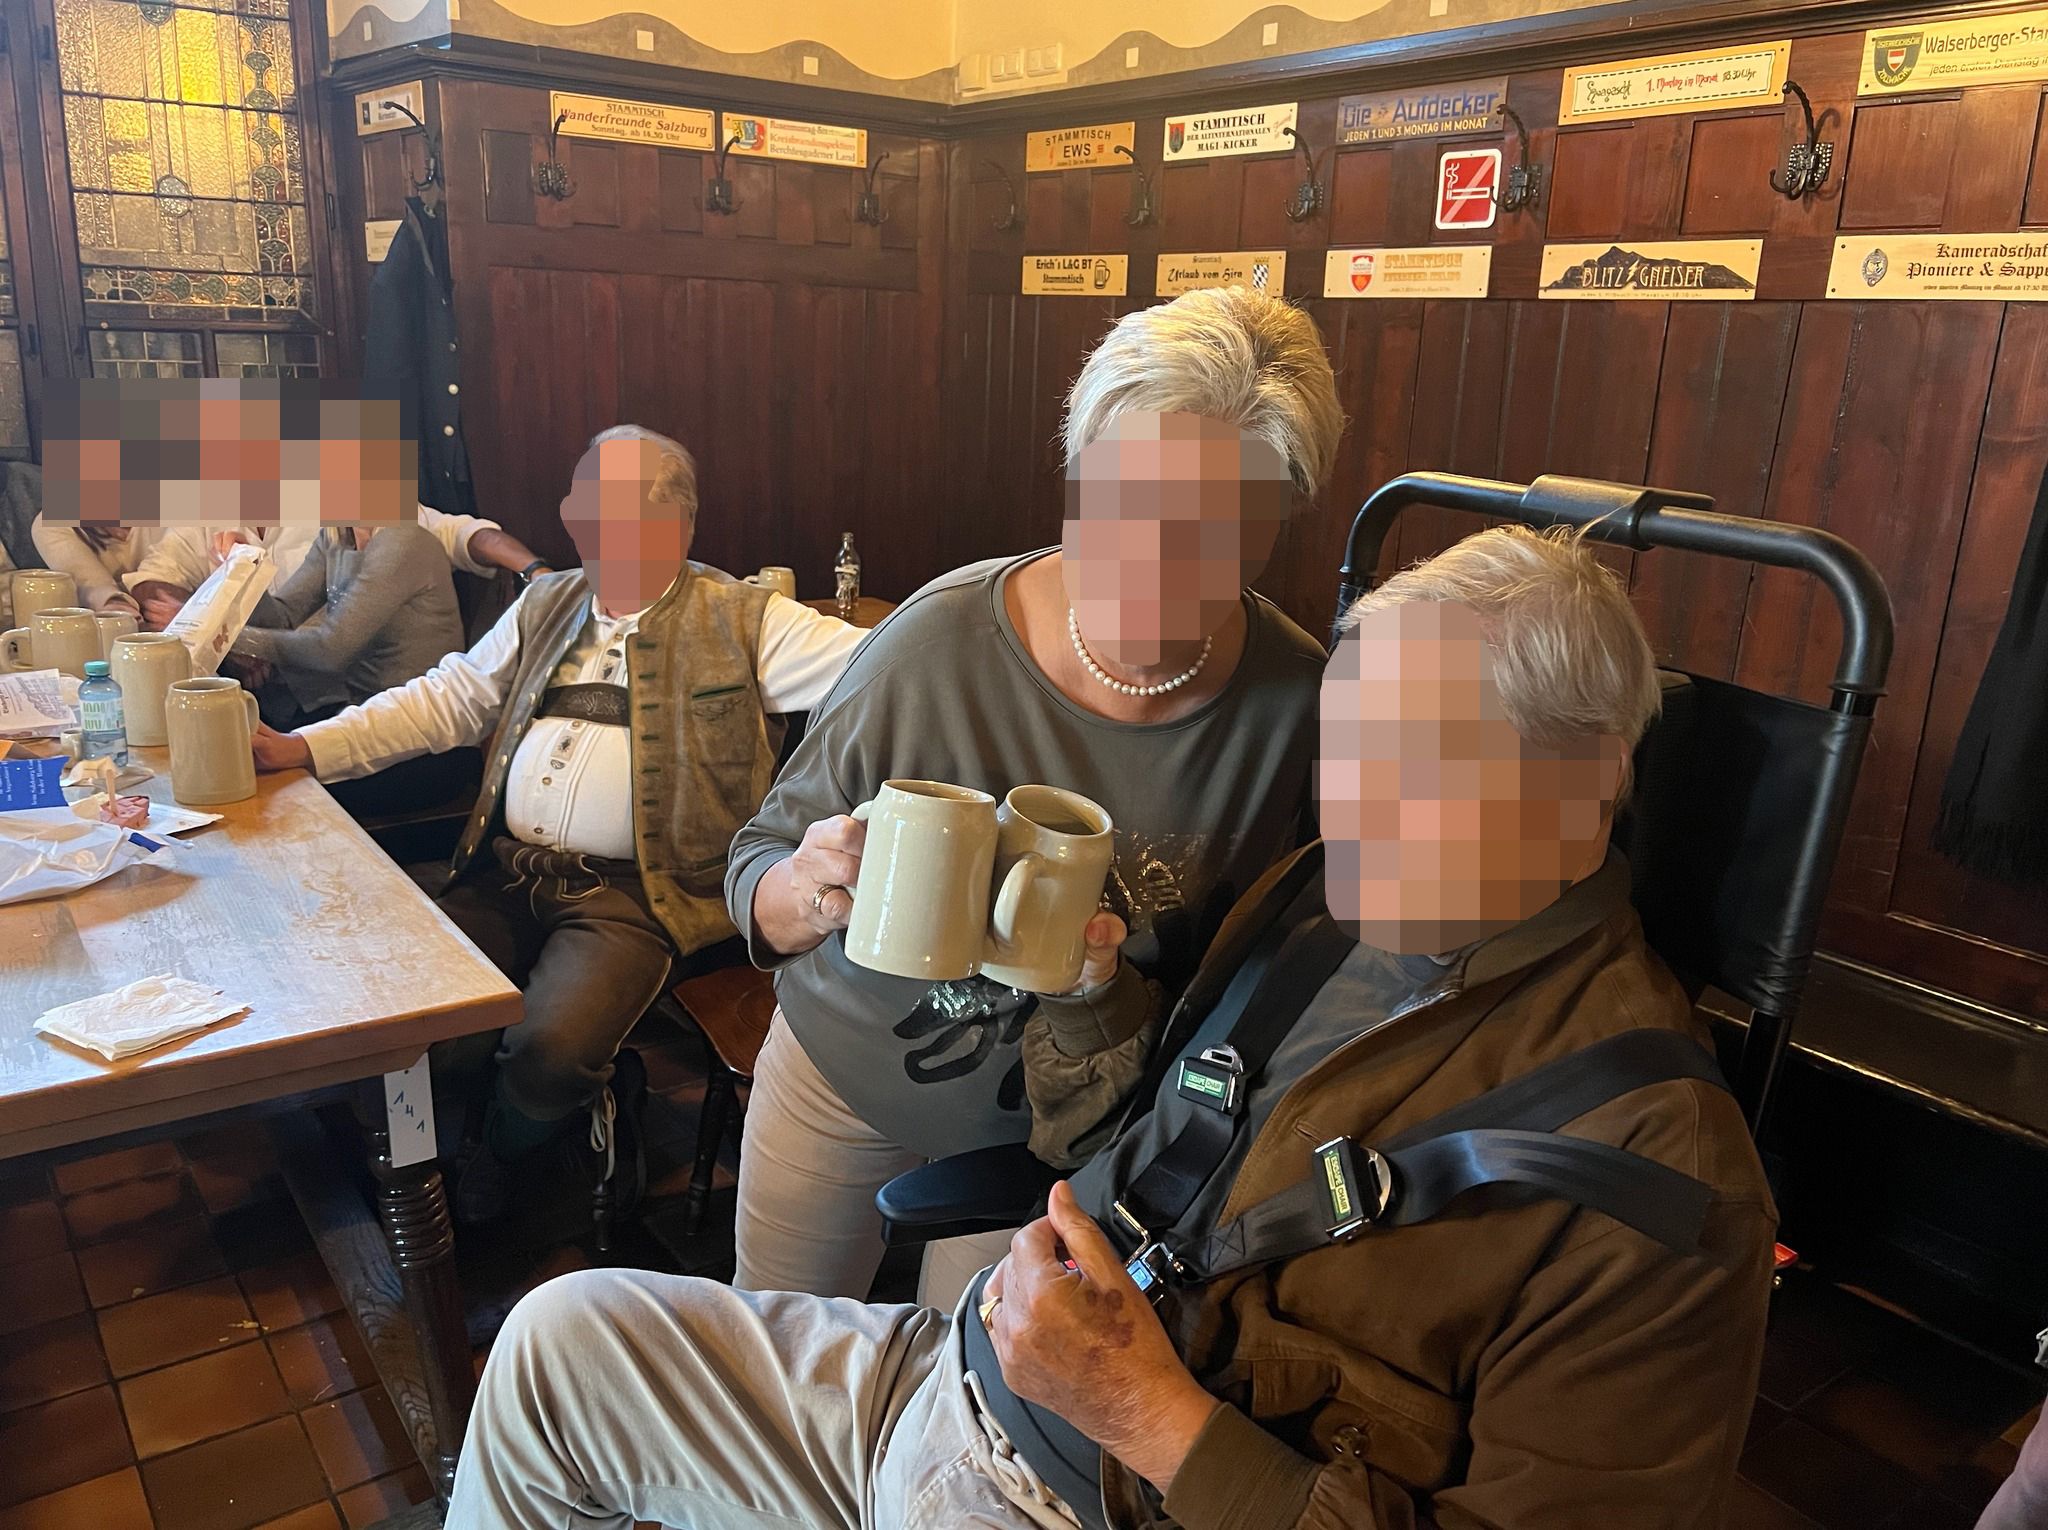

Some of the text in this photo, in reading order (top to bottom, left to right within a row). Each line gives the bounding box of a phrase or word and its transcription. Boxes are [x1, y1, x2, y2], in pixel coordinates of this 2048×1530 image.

[606, 103, 665, 118] STAMMTISCH
[1343, 88, 1499, 129] Die Aufdecker
[560, 108, 708, 137] Wanderfreunde Salzburg
[1192, 113, 1266, 131] STAMMTISCH
[1344, 130, 1370, 143] JEDEN
[1377, 128, 1394, 139] UND
[1403, 122, 1439, 136] MONTAG
[1440, 120, 1452, 132] IM
[1454, 117, 1488, 131] MONAT
[1045, 129, 1112, 147] STAMMTISCH
[1063, 143, 1091, 158] EWS
[1062, 258, 1080, 270] L&G
[1082, 258, 1093, 269] BT
[1906, 262, 1974, 279] Pioniere
[1979, 261, 1994, 277] &
[1167, 267, 1200, 282] Urlaub
[1202, 271, 1219, 280] vom
[1582, 265, 1704, 288] BLITZ GNEISER
[1206, 1079, 1222, 1091] CHAIR
[1337, 1187, 1348, 1211] CHAIR
